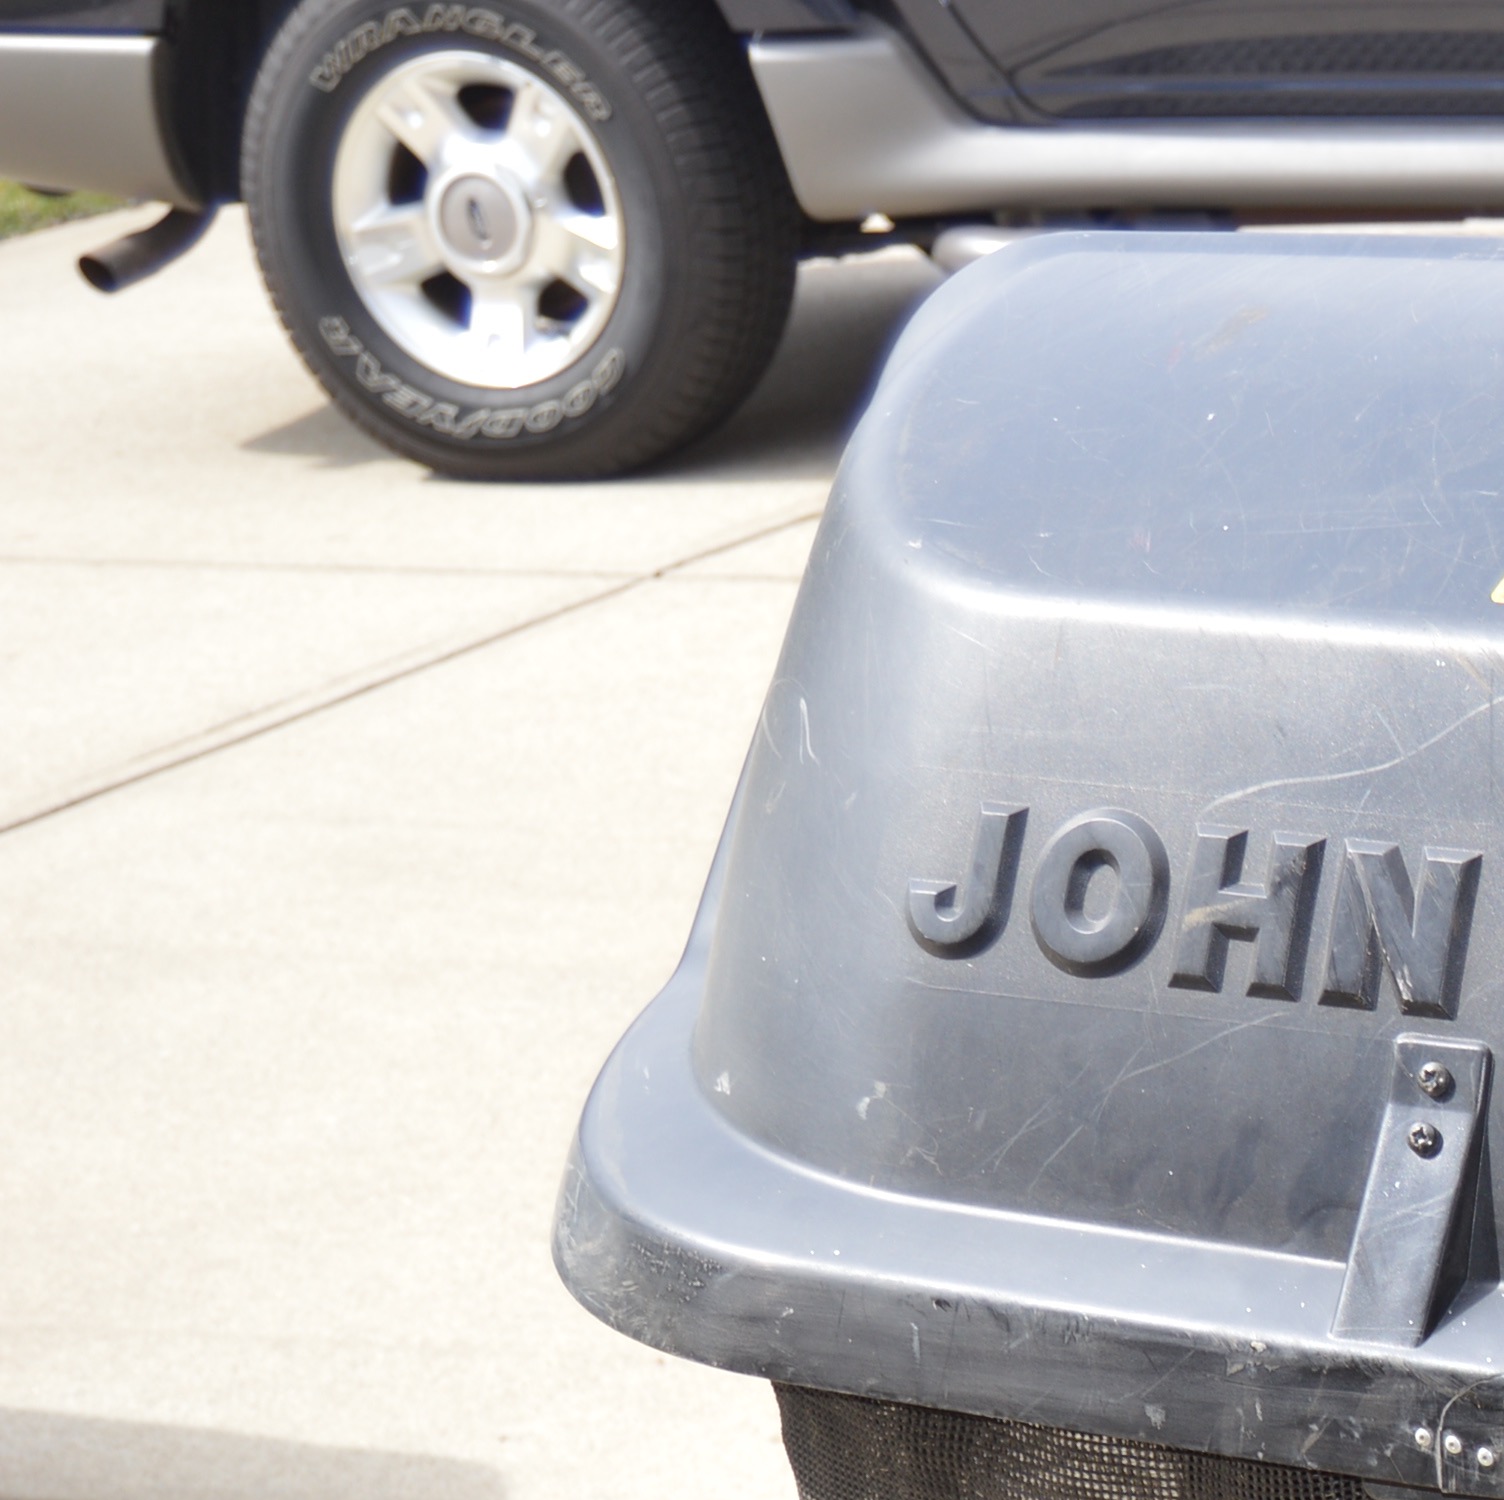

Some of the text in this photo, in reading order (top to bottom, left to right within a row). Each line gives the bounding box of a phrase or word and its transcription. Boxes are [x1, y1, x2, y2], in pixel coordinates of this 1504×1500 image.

[309, 3, 612, 120] WRANGLER
[319, 315, 625, 439] GOODYEAR
[906, 802, 1481, 1021] JOHN
